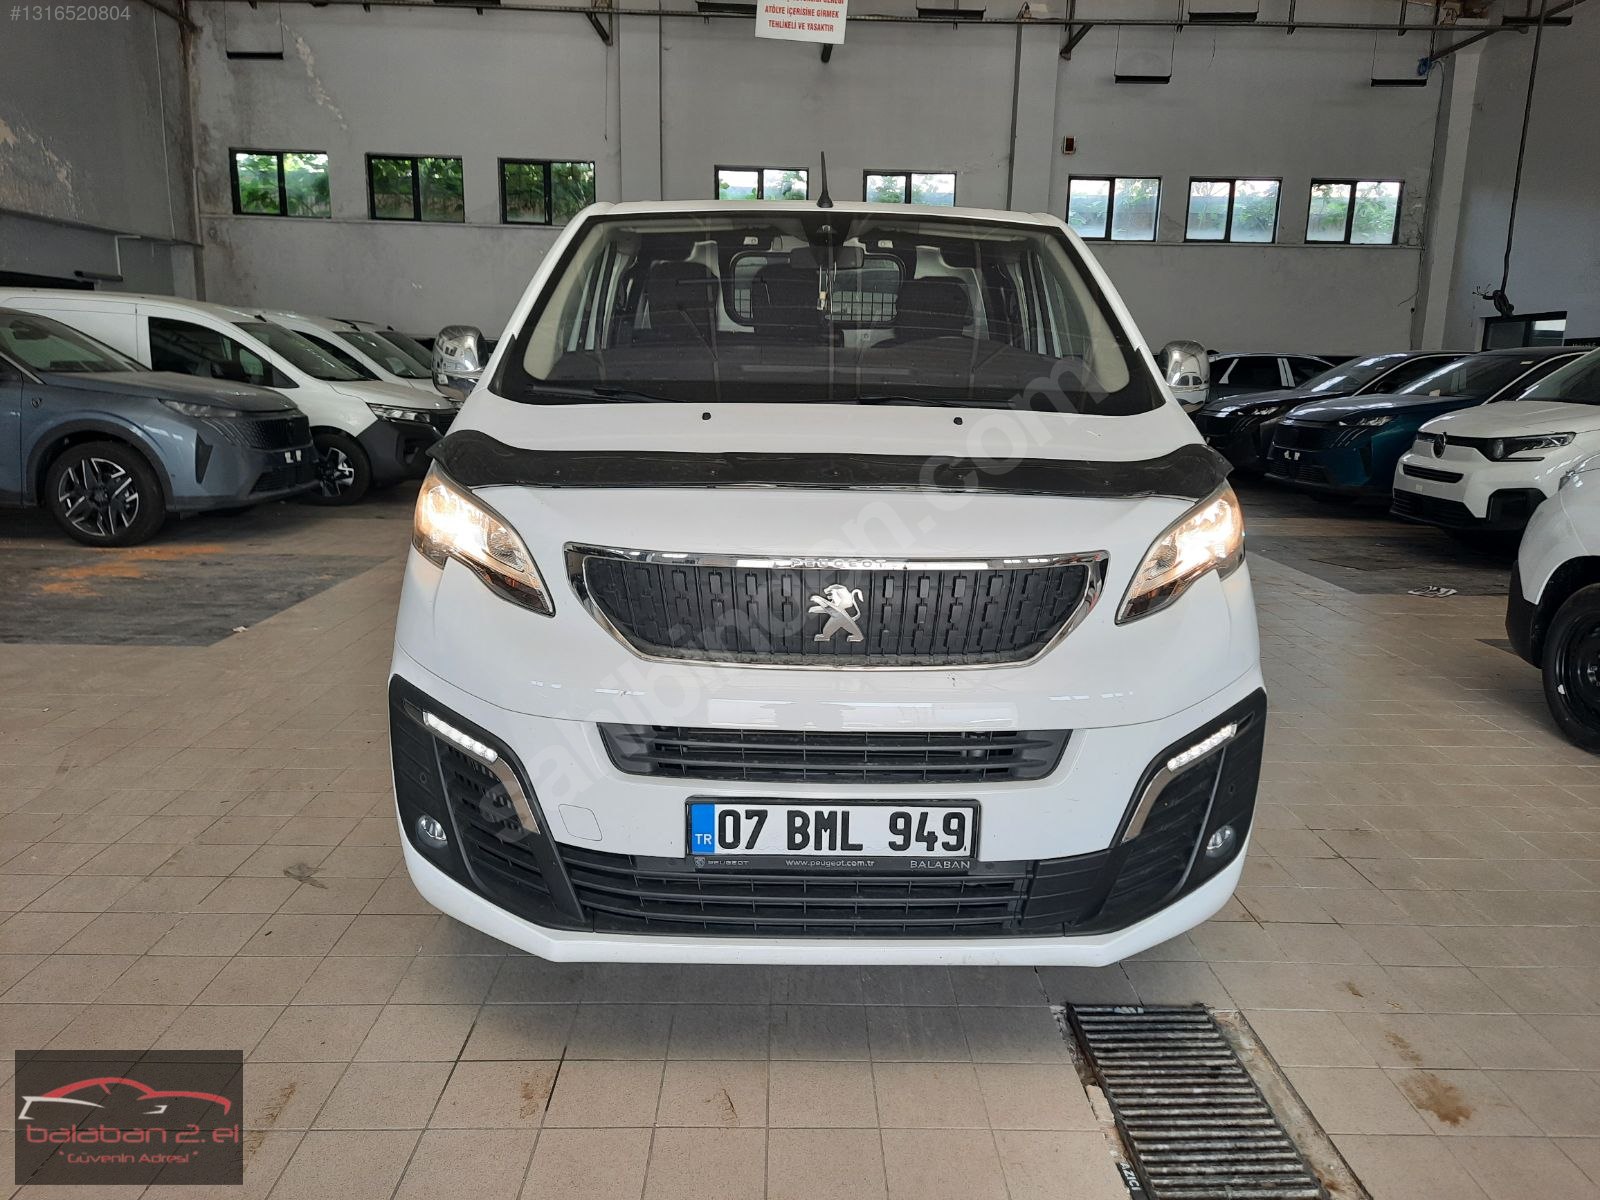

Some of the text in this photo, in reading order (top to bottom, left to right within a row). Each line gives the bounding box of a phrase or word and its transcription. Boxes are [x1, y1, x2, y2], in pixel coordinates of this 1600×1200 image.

[798, 22, 805, 30] VE
[807, 23, 834, 32] YASAKTIR
[790, 558, 887, 568] PEUGEOT
[718, 809, 966, 852] 07 BML 949
[695, 833, 712, 845] TR
[910, 860, 970, 869] BALABAN
